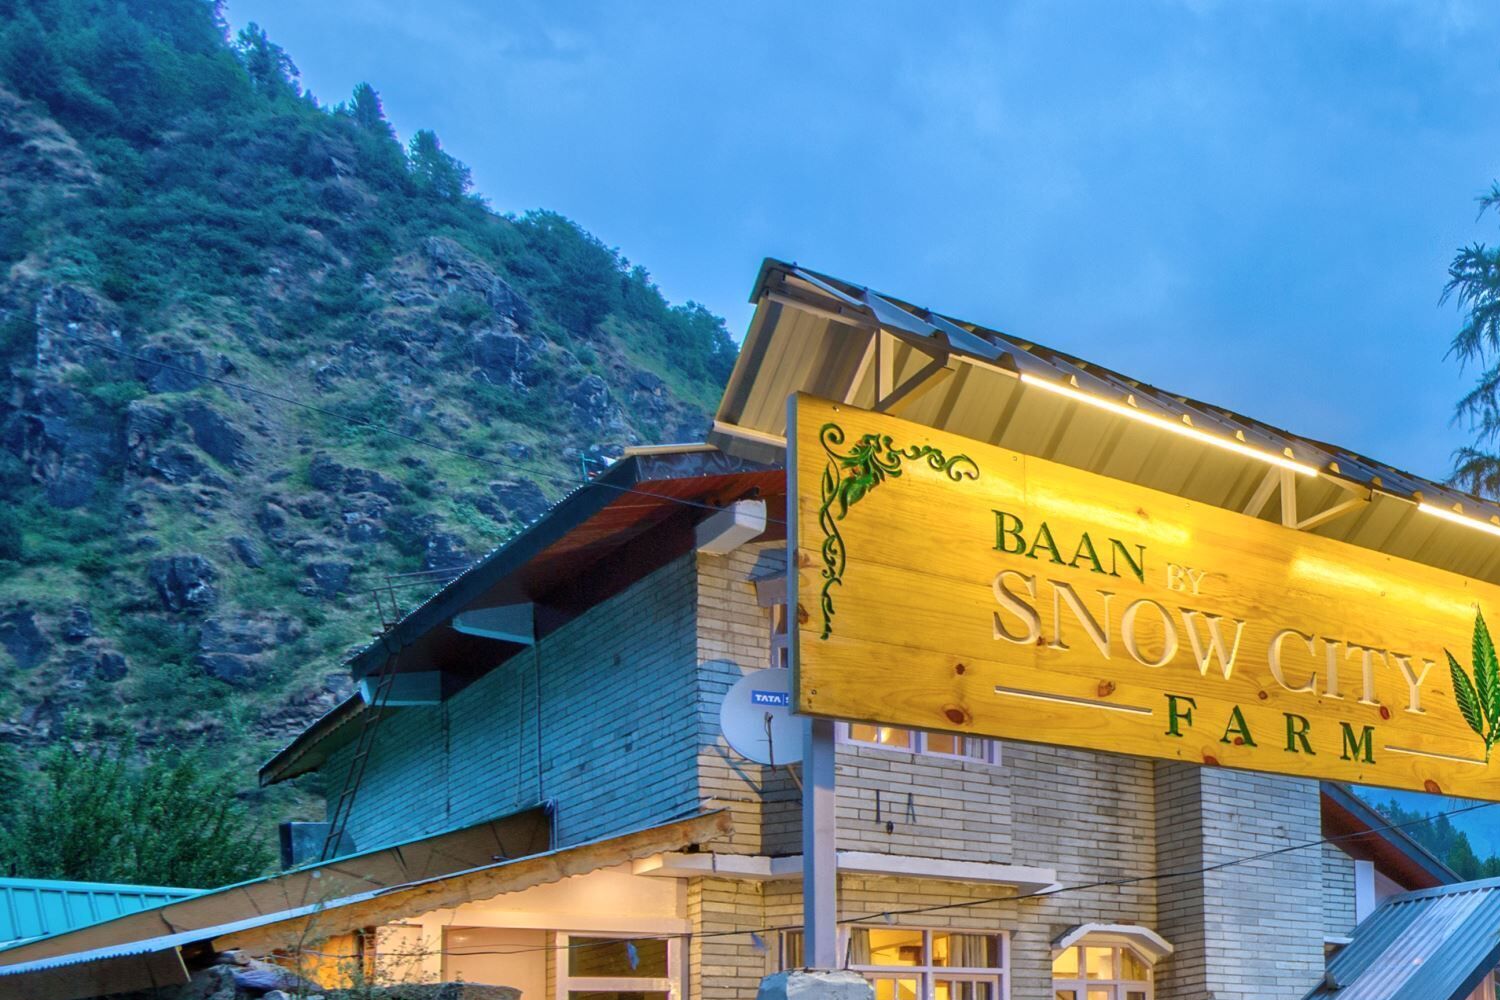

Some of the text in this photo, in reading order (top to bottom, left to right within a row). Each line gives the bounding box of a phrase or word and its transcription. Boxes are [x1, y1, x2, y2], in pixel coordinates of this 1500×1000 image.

[992, 509, 1208, 595] BAAN BY
[992, 569, 1436, 715] SNOW CITY
[755, 694, 782, 704] TATA
[1165, 692, 1377, 764] FARM
